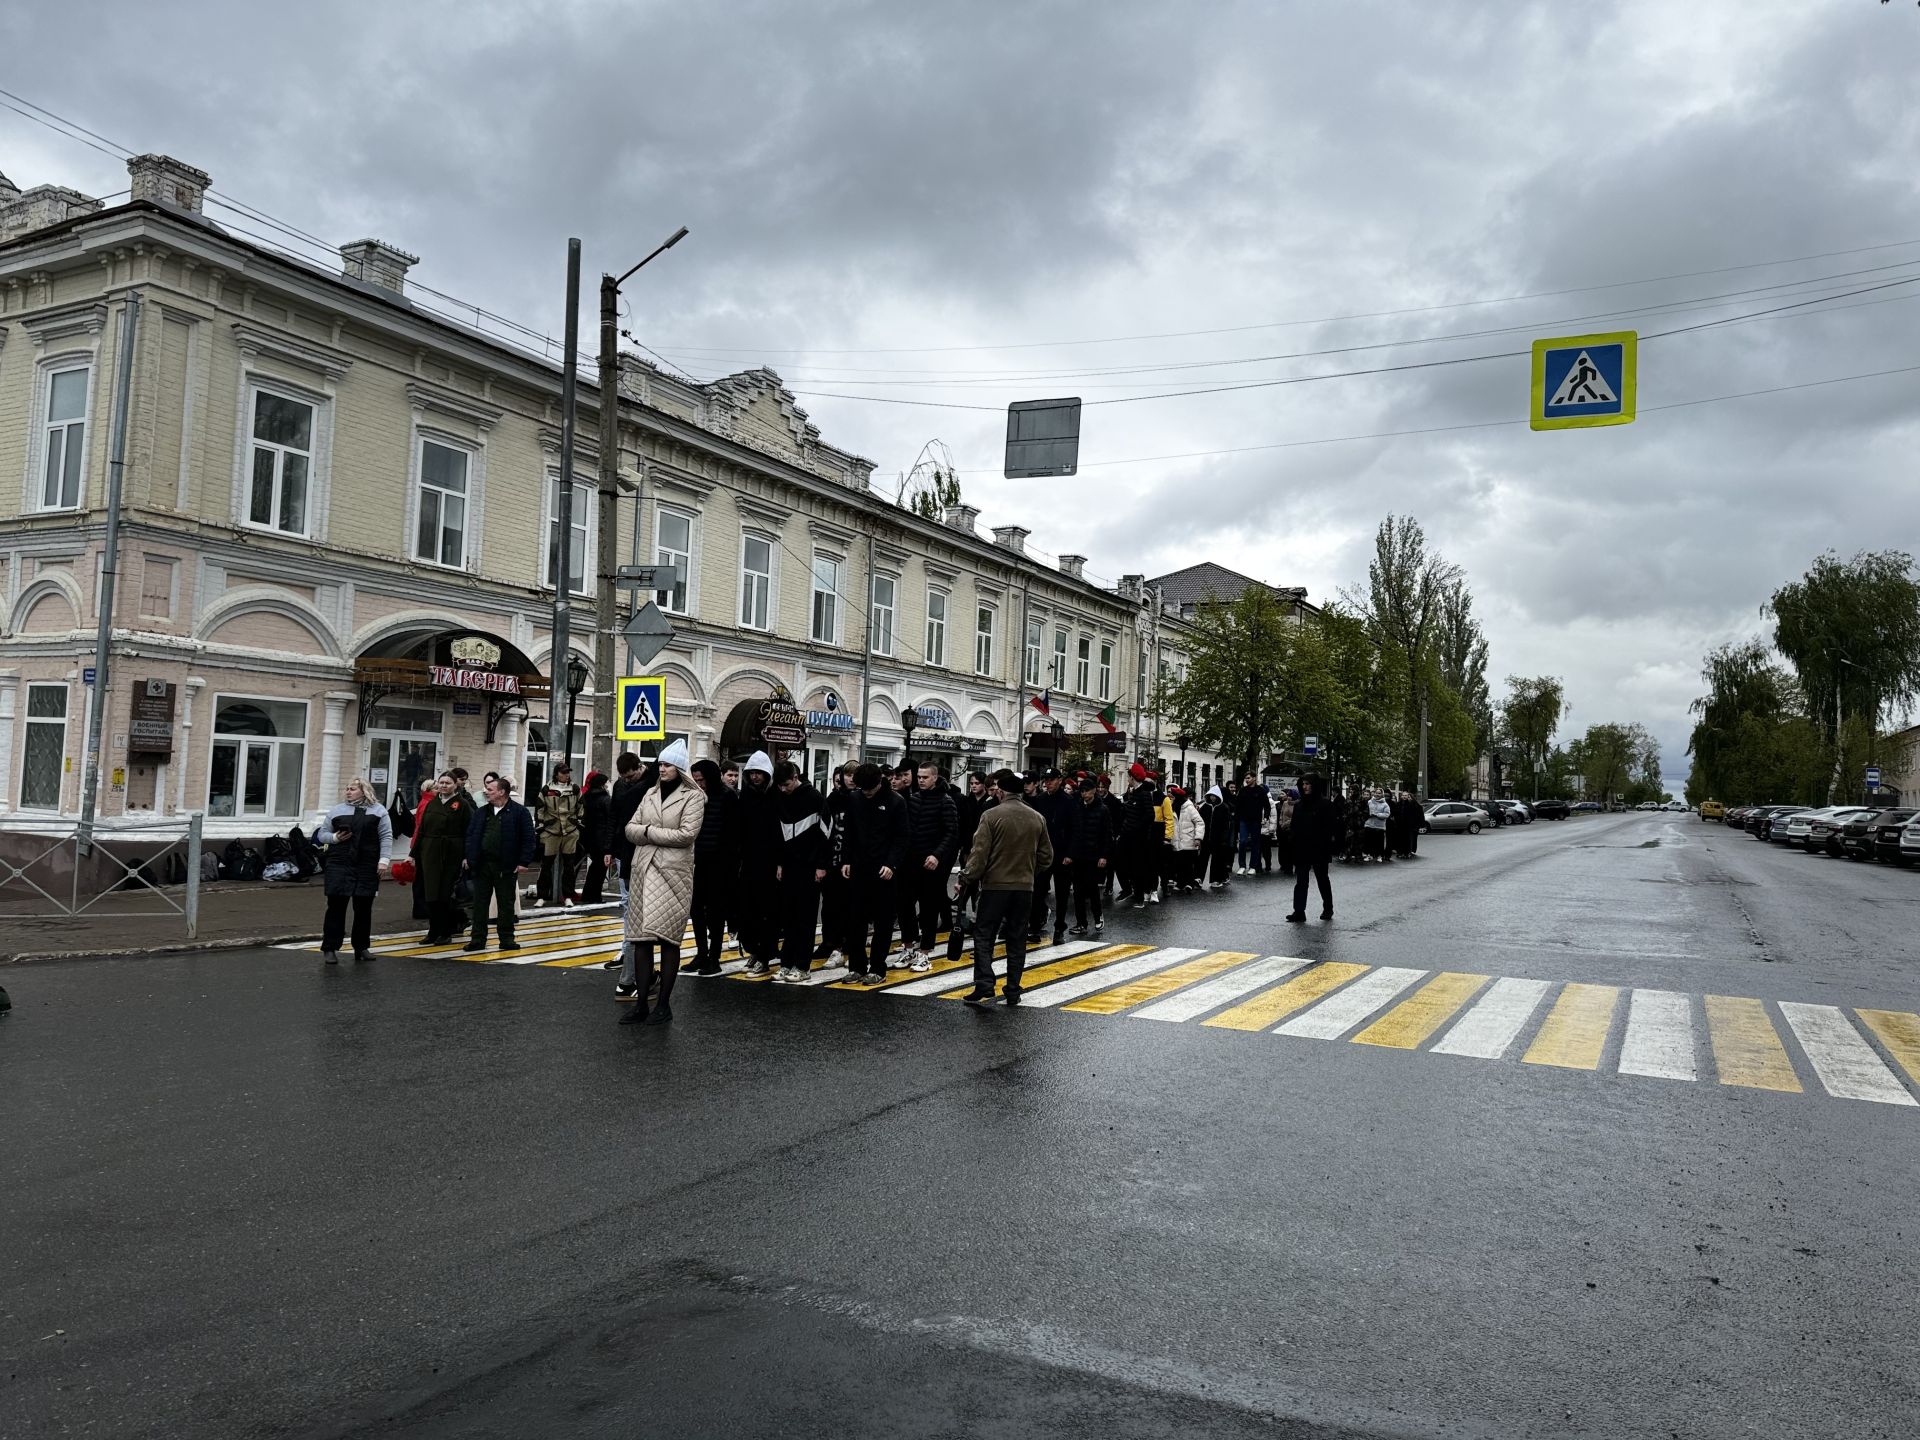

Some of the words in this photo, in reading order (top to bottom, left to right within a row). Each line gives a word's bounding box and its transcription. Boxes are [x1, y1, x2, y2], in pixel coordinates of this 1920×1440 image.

[430, 666, 520, 694] ТАВЕРНА
[758, 700, 806, 725] Элегант
[808, 711, 853, 729] ЦУНАМИ
